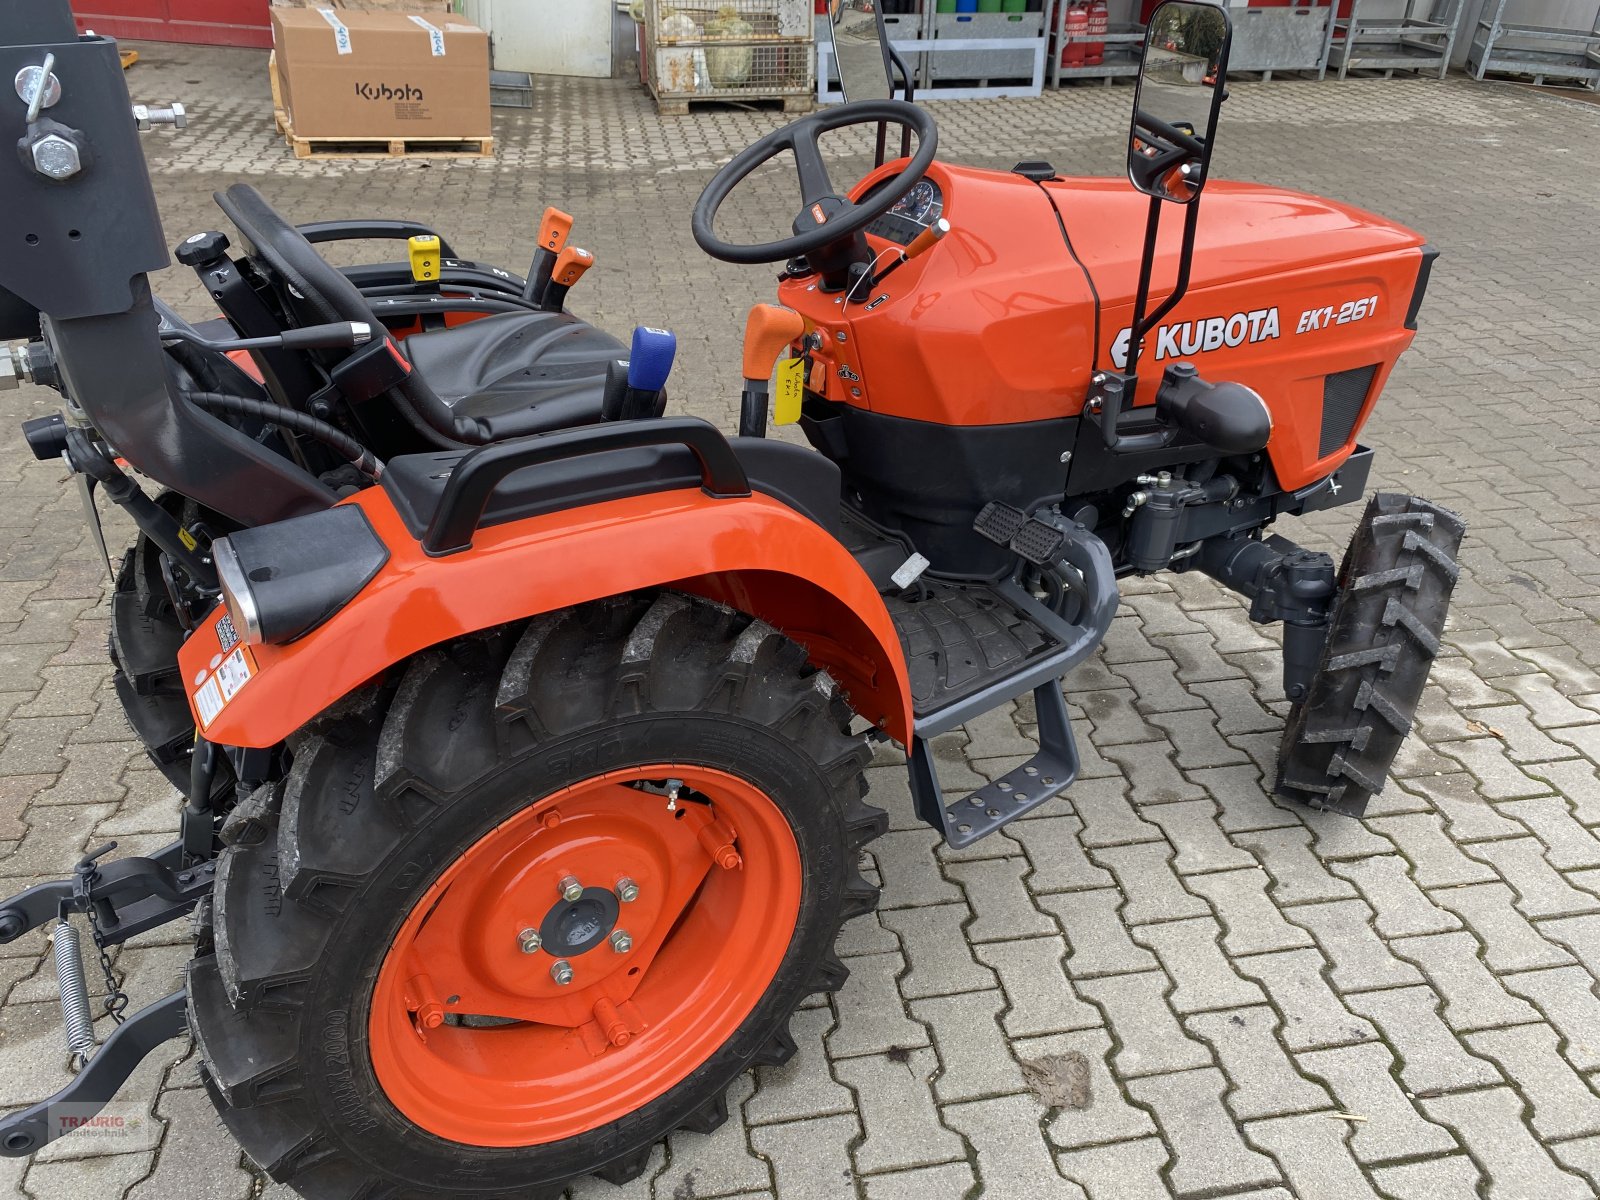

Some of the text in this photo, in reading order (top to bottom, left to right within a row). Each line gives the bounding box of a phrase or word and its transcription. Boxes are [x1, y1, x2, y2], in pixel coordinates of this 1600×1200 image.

[355, 82, 423, 101] Kubota
[1154, 295, 1379, 361] KUBOTA EK1-261
[320, 1009, 349, 1068] 2000
